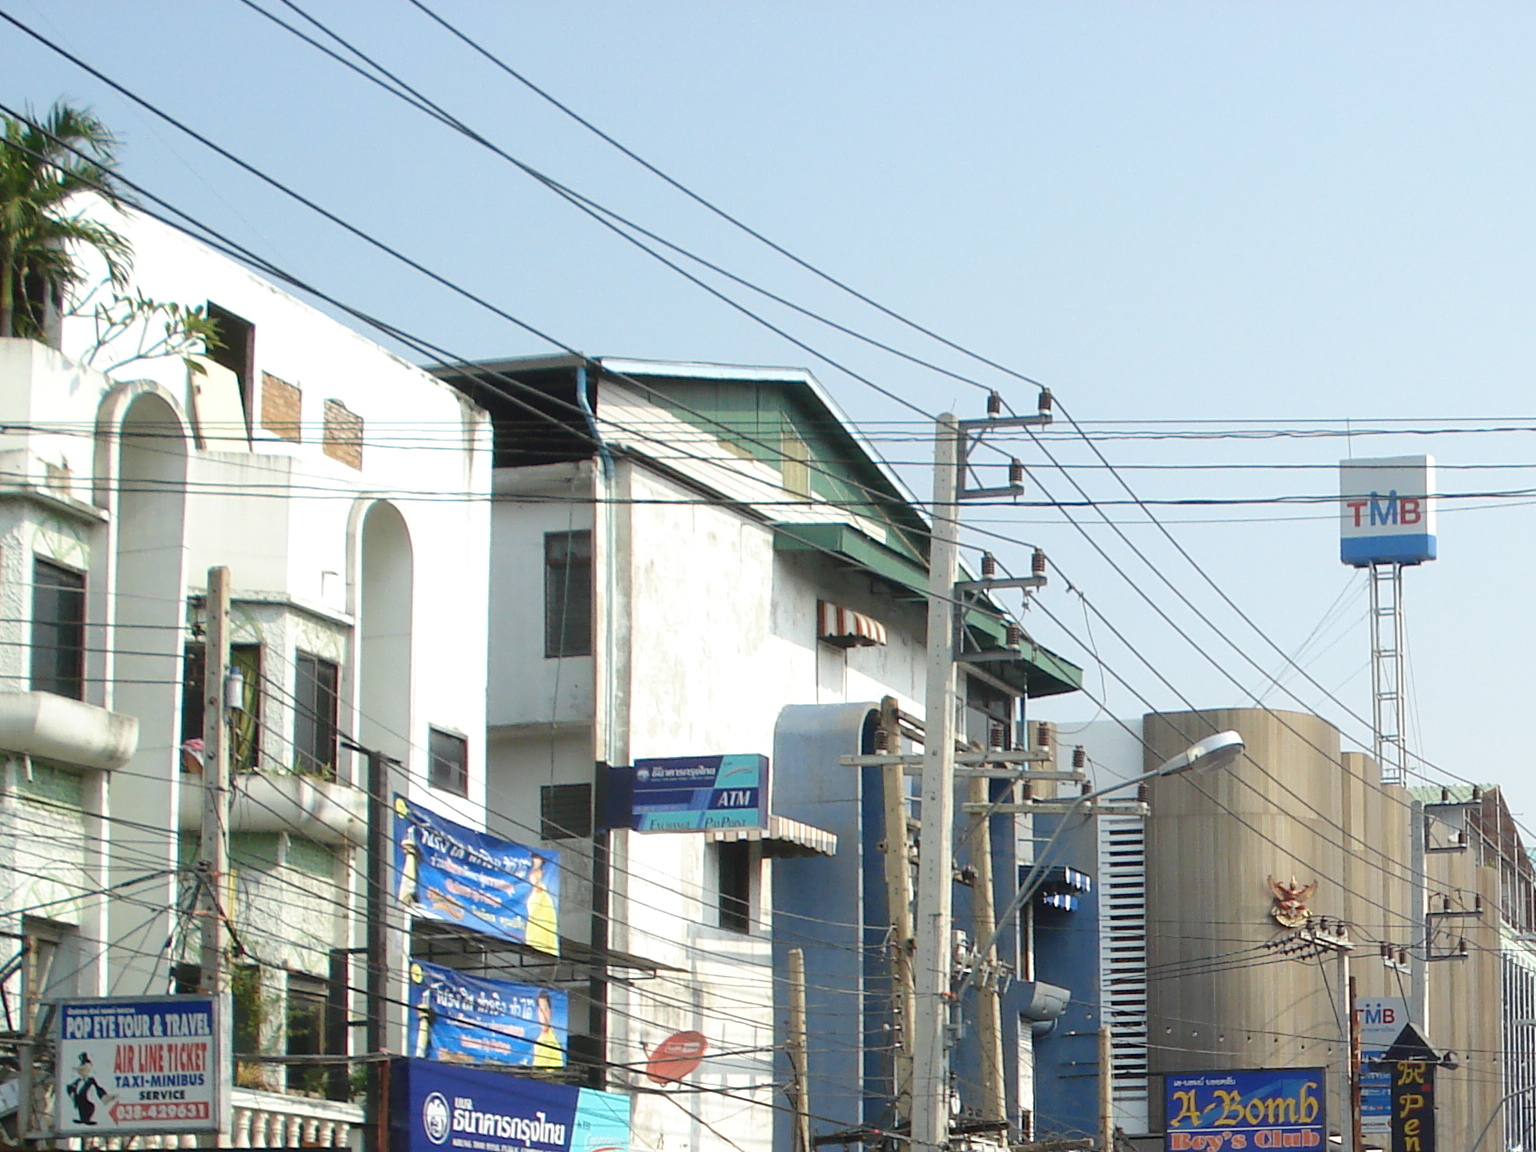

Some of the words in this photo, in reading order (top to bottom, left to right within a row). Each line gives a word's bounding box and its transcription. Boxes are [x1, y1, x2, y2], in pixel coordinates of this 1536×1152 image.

[1347, 490, 1421, 527] TMB
[718, 790, 751, 807] ATM
[66, 1015, 92, 1039] POP
[94, 1014, 116, 1038] EYE
[118, 1013, 150, 1037] TOUR
[152, 1013, 163, 1037] &
[165, 1012, 211, 1036] TRAVEL
[114, 1045, 135, 1074] AIR
[138, 1044, 164, 1073] LINE
[167, 1042, 207, 1072] TICKET
[115, 1073, 205, 1088] TAXI-MINIBUS
[139, 1090, 186, 1100] SERVICE
[1171, 1082, 1319, 1128] A-Bomb
[116, 1103, 206, 1120] 038-429631
[452, 1109, 566, 1147] ธนาคารกรุงไทย
[1254, 1129, 1320, 1148] Club
